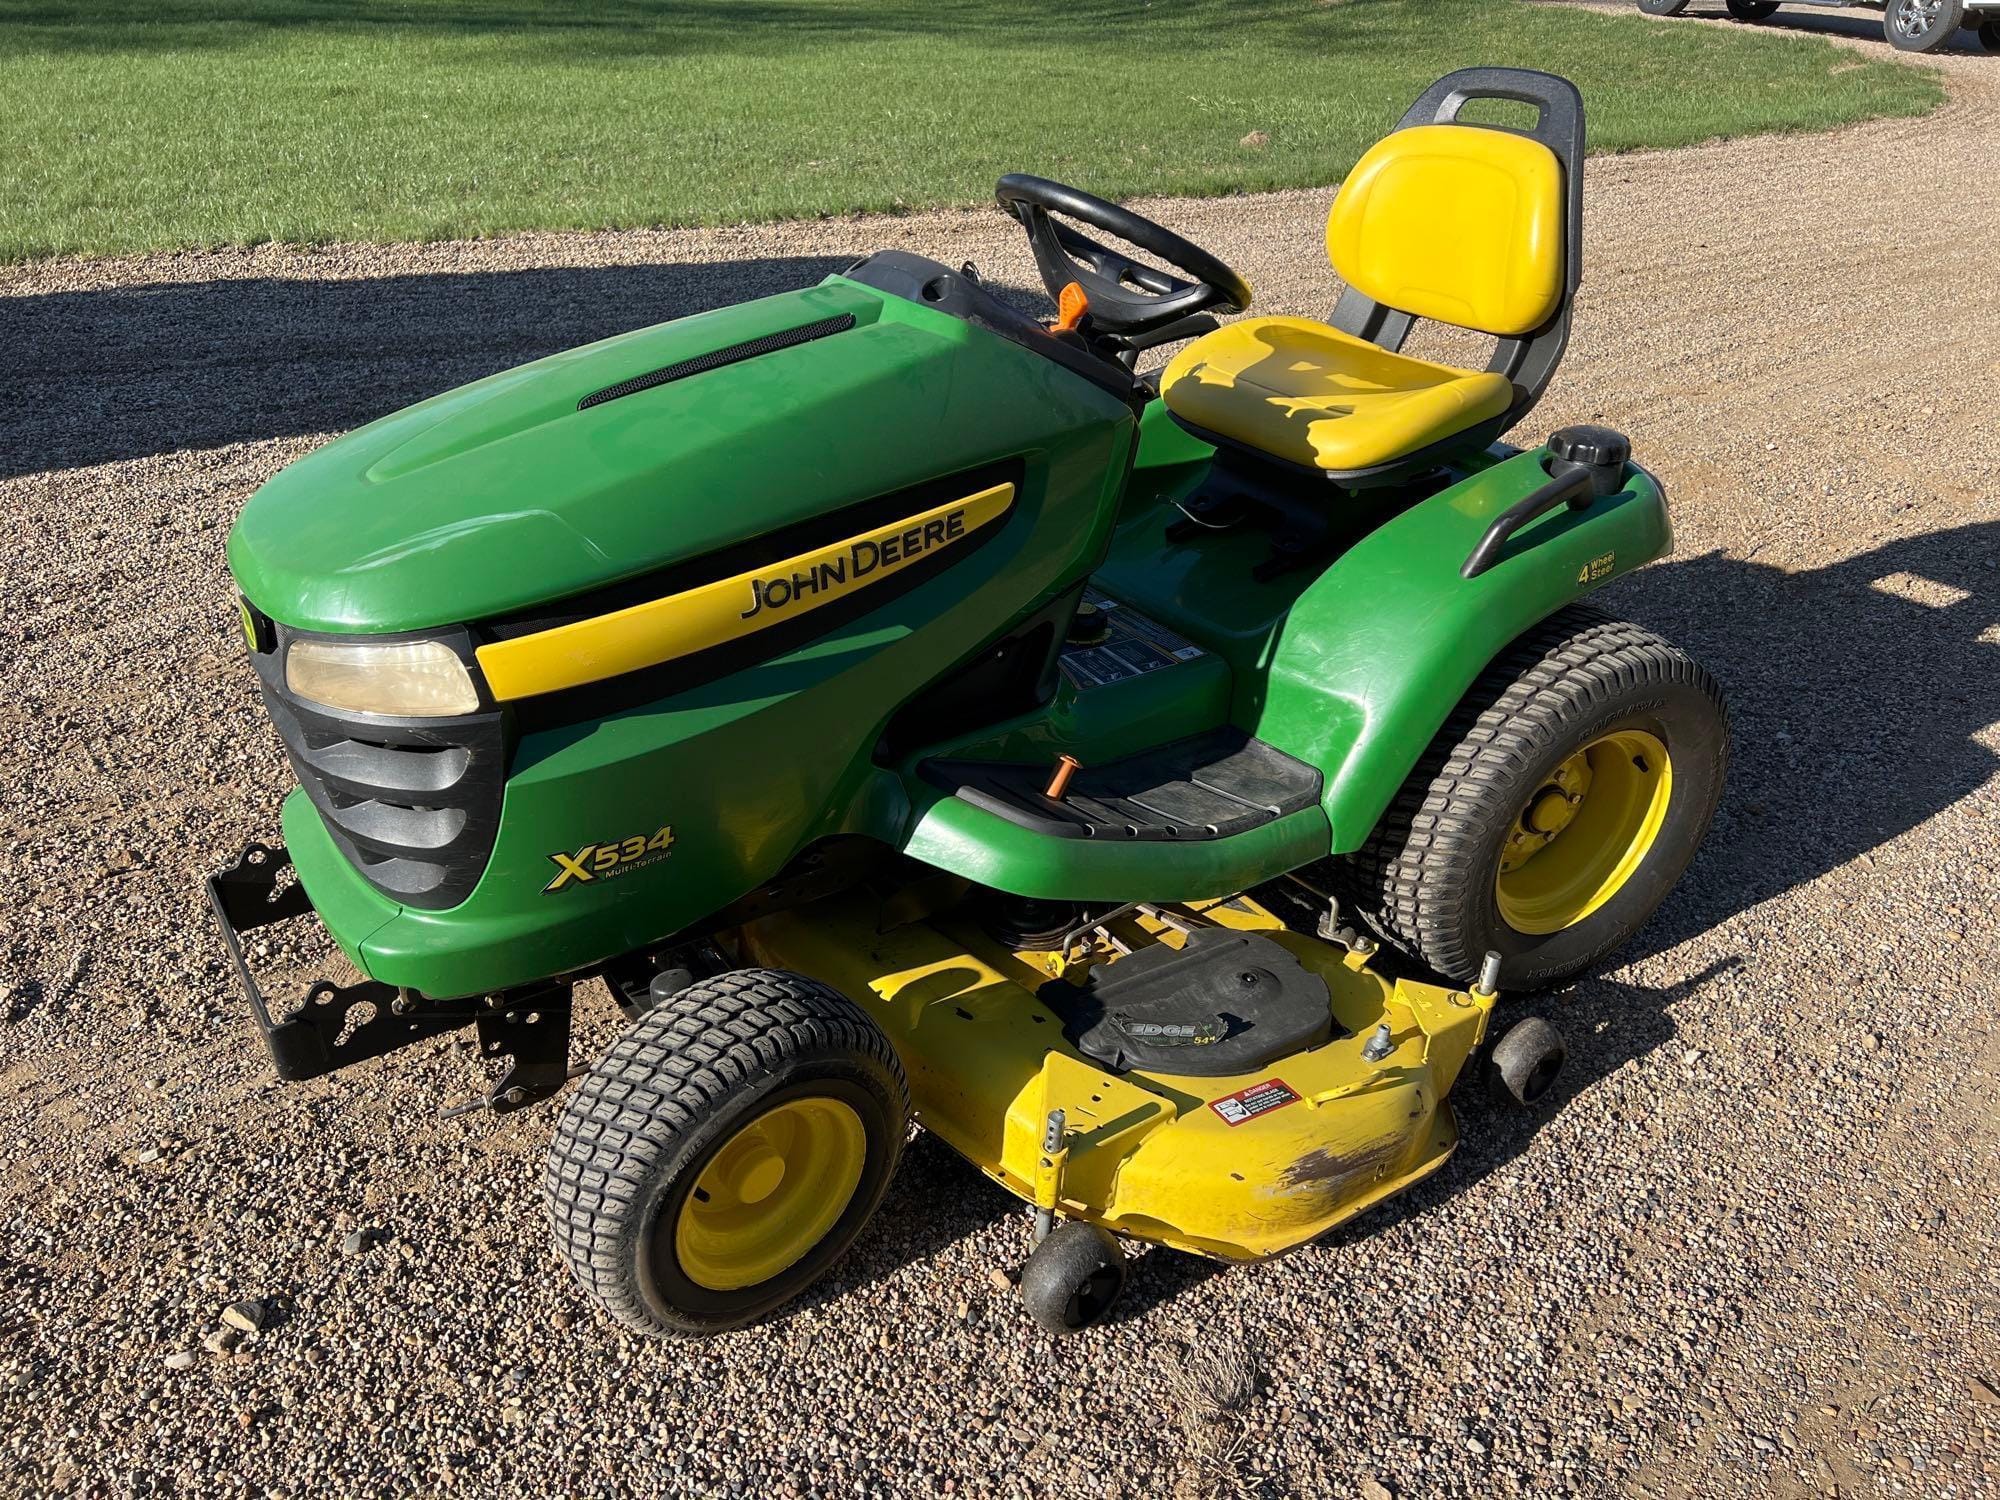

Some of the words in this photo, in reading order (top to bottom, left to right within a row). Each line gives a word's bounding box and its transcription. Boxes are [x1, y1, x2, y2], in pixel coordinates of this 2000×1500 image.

[740, 556, 846, 619] JOHN
[850, 508, 965, 579] DEERE
[1578, 565, 1590, 583] 4
[543, 824, 676, 892] X534
[605, 850, 673, 880] Multi-Terrain
[1127, 1022, 1197, 1037] EDGE
